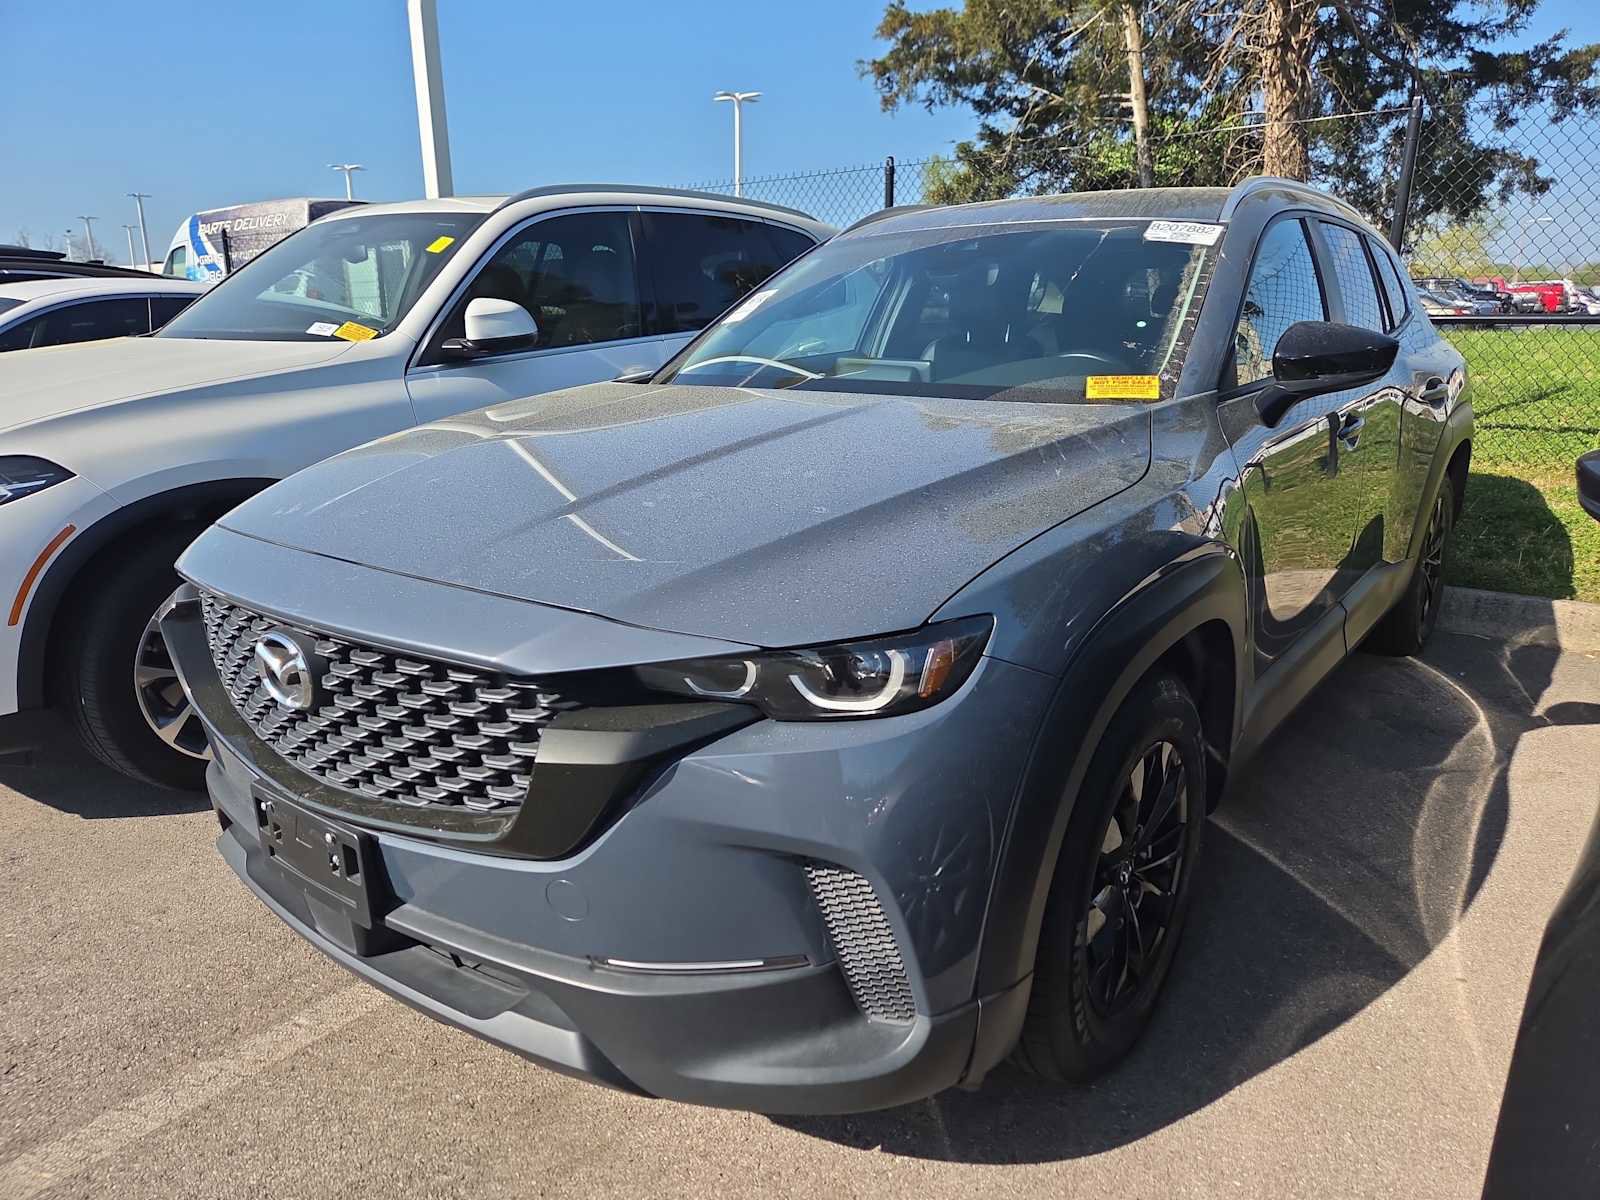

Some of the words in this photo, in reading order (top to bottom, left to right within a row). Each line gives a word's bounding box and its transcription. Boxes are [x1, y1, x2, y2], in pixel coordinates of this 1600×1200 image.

[199, 221, 232, 235] PARTS
[234, 214, 289, 231] DELIVERY
[1151, 222, 1216, 234] 8207882
